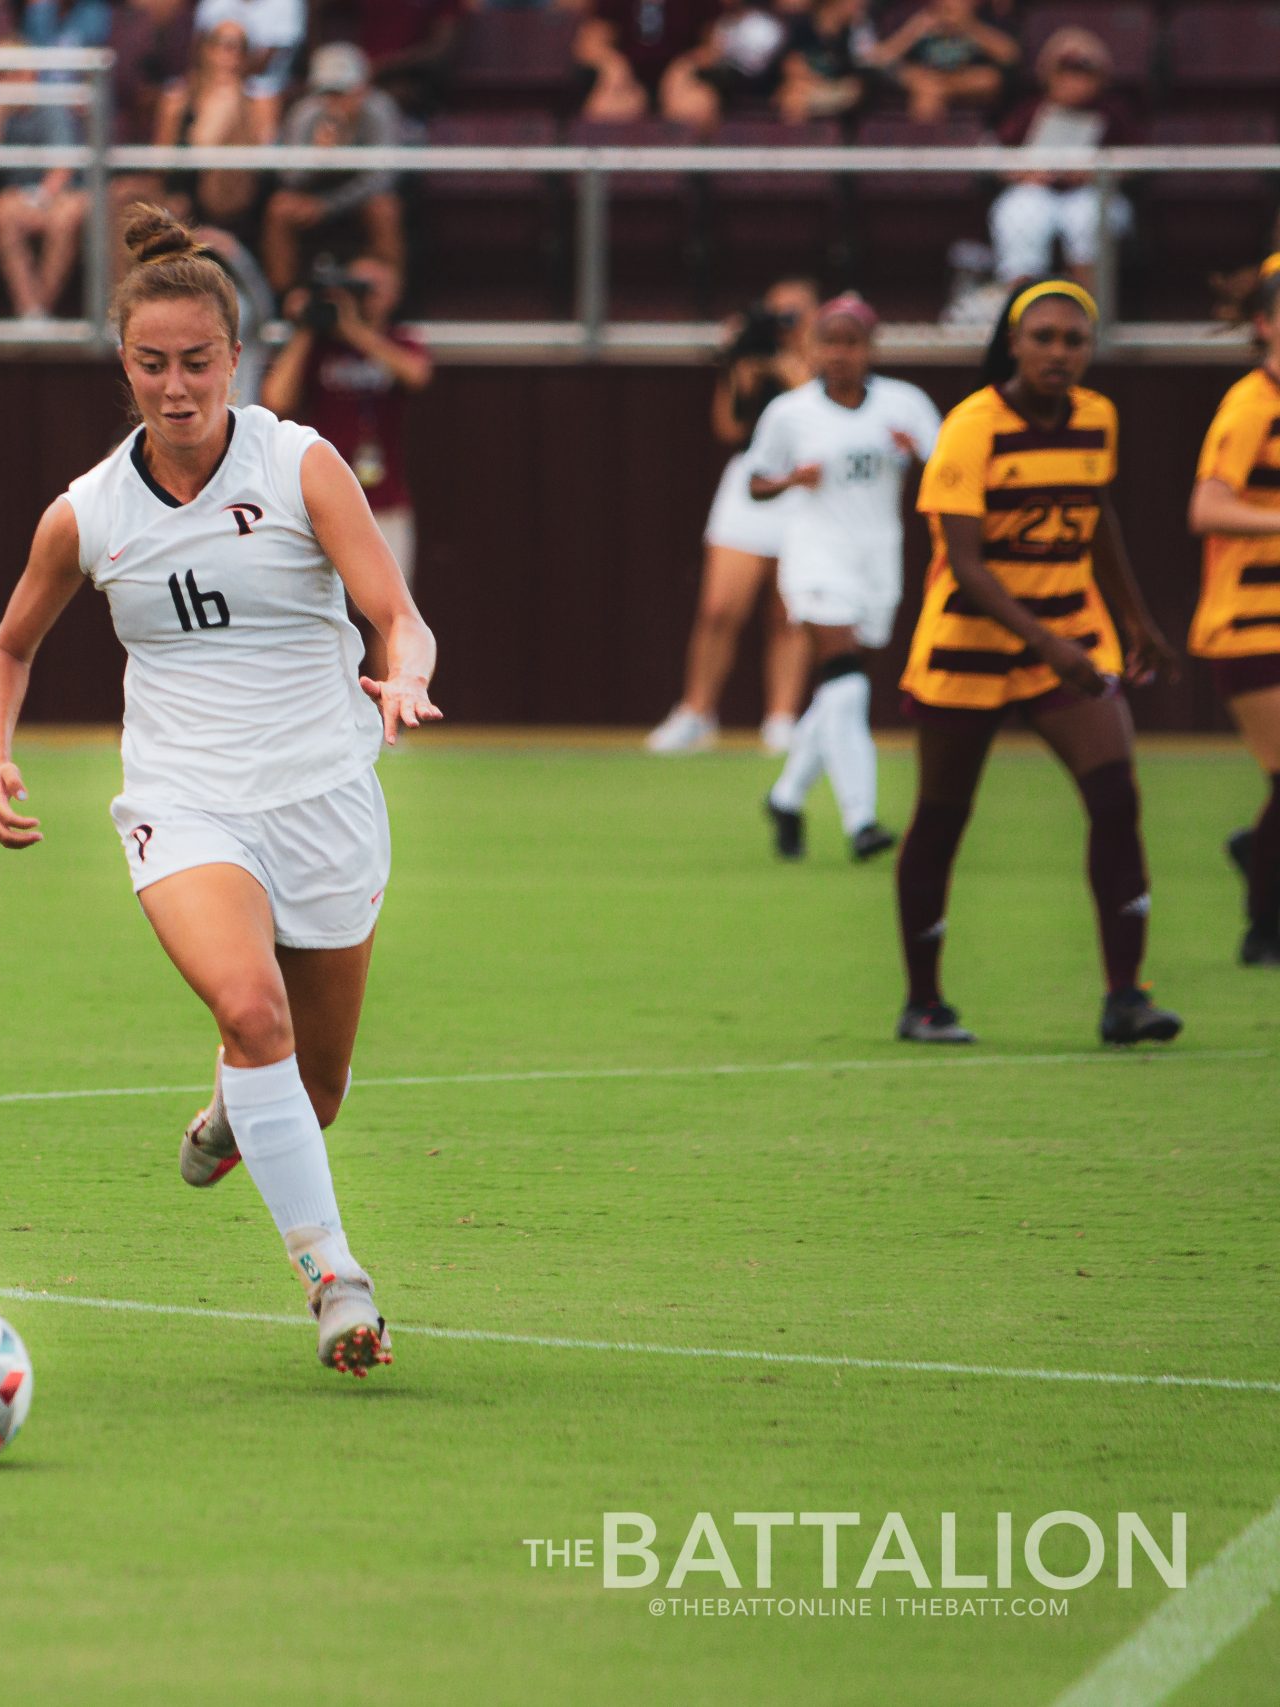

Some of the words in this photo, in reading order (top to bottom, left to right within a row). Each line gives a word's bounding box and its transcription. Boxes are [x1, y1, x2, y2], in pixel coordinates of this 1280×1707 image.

[223, 502, 263, 536] P
[1009, 494, 1095, 554] 25
[168, 568, 230, 632] 16
